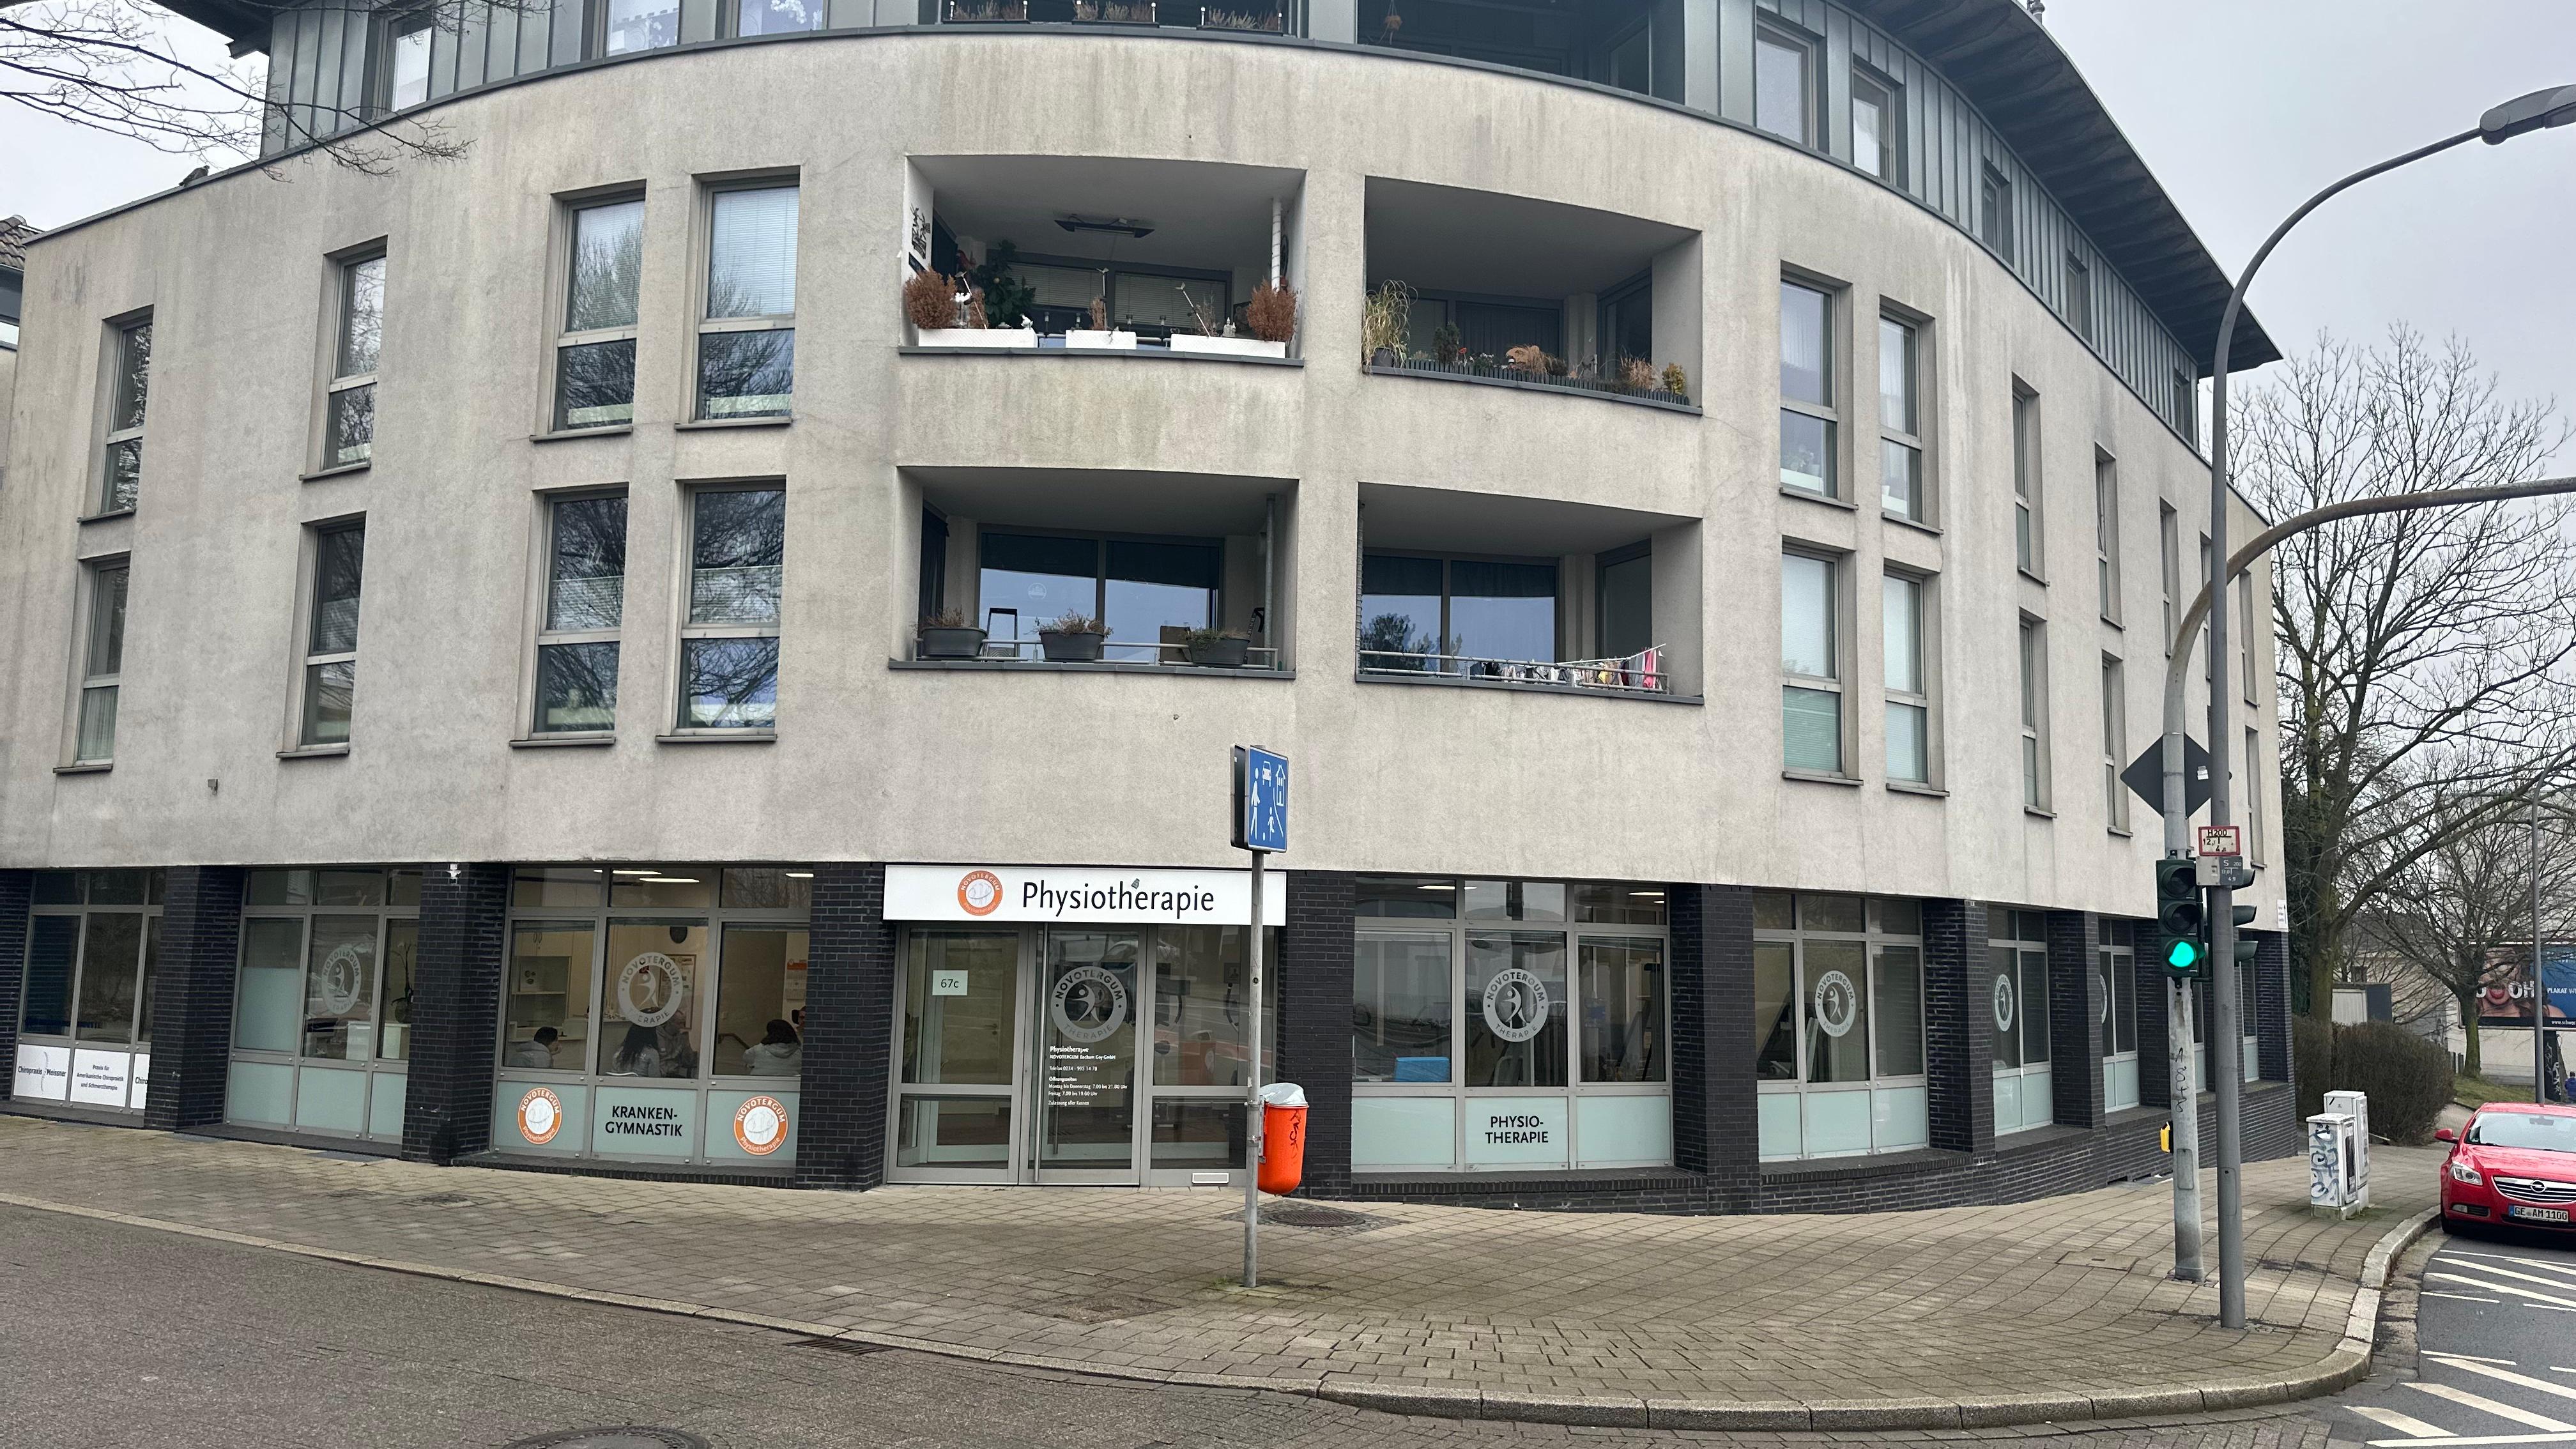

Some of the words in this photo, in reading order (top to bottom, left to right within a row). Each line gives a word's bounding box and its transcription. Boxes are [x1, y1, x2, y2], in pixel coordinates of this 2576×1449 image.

[960, 873, 1000, 891] NOVOTERGUM
[1023, 880, 1214, 919] Physiotherapie
[622, 956, 680, 986] NOVOTERGUM
[940, 978, 959, 988] 67c
[1055, 969, 1123, 1000] NOVOTERGUM
[1064, 1025, 1113, 1039] THERAPIE
[18, 1066, 42, 1075] Chiropraxis
[46, 1069, 66, 1077] Meissner
[521, 1089, 560, 1114] NOVOTERGUM
[612, 1105, 678, 1120] KRANKEN-
[737, 1098, 786, 1123] NOVOTERGUM
[605, 1121, 683, 1137] GYMNASTIK
[1491, 1116, 1544, 1128] PHYSIO-
[523, 1126, 555, 1141] Physiotherapie
[1485, 1131, 1549, 1144] THERAPIE
[740, 1137, 781, 1152] Physiotherapie
[2515, 1207, 2526, 1216] GE
[2532, 1209, 2543, 1218] AM
[2545, 1210, 2567, 1220] 1100
